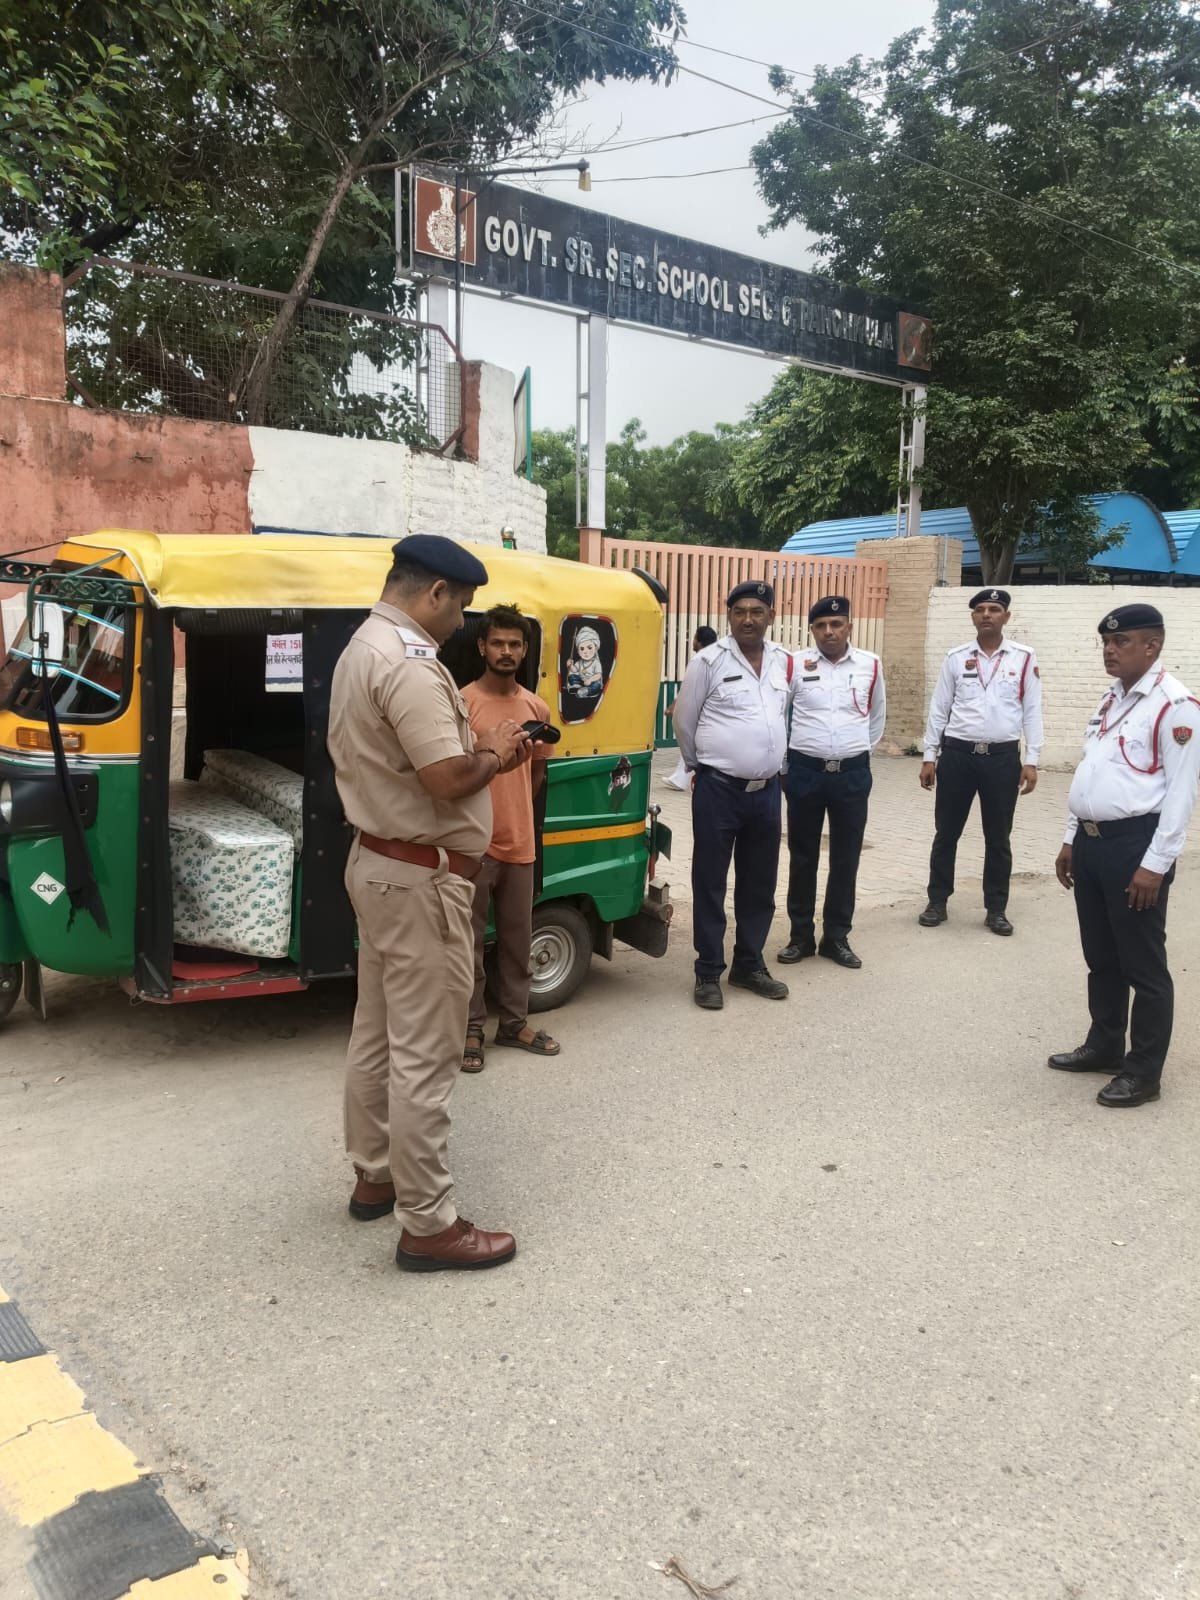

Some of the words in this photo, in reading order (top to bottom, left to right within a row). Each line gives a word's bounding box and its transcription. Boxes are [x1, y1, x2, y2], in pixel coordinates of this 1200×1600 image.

[484, 215, 557, 268] GOVT.
[564, 237, 601, 279] SR.
[605, 247, 652, 292] SEC.
[657, 261, 734, 313] SCHOOL
[36, 883, 58, 893] CNG
